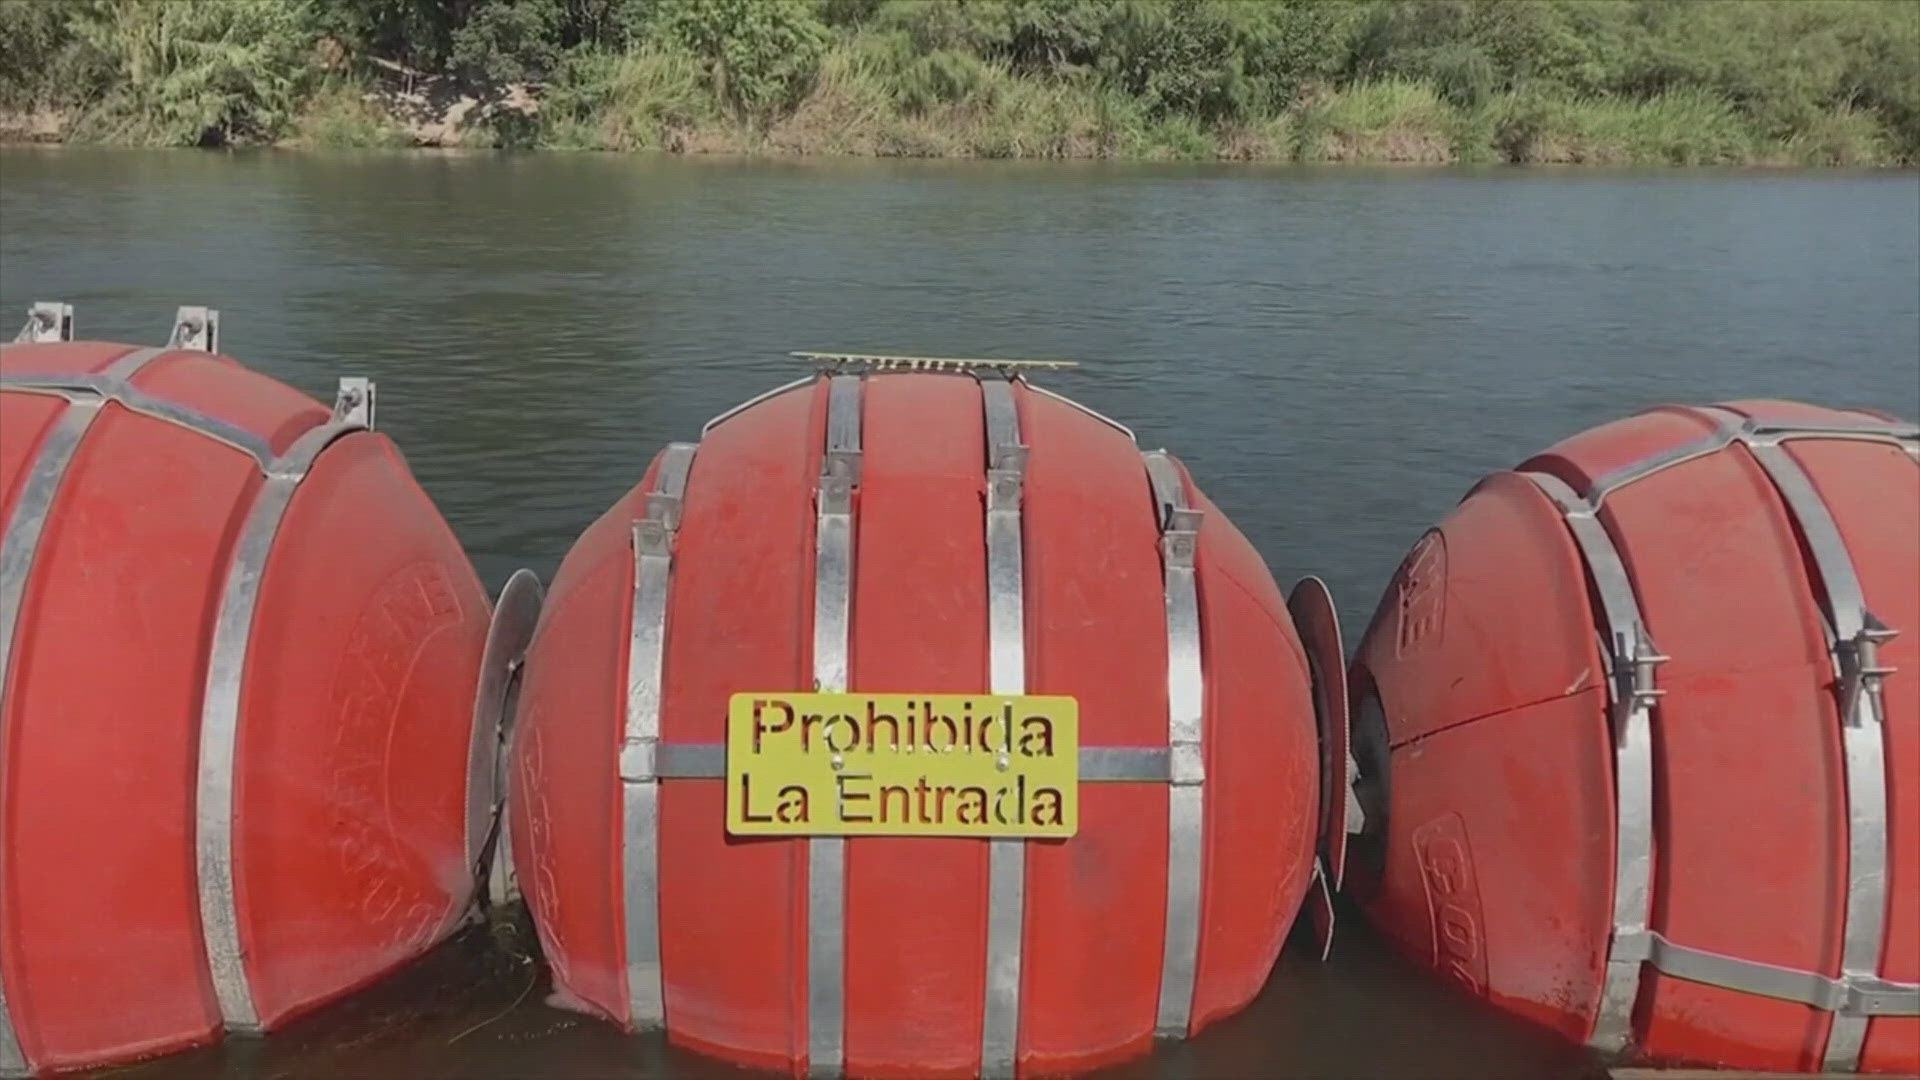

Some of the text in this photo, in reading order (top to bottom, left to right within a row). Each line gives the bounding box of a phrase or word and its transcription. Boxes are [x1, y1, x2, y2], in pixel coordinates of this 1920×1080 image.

[751, 700, 1054, 758] Prohibida
[741, 773, 1064, 826] La Entrada
